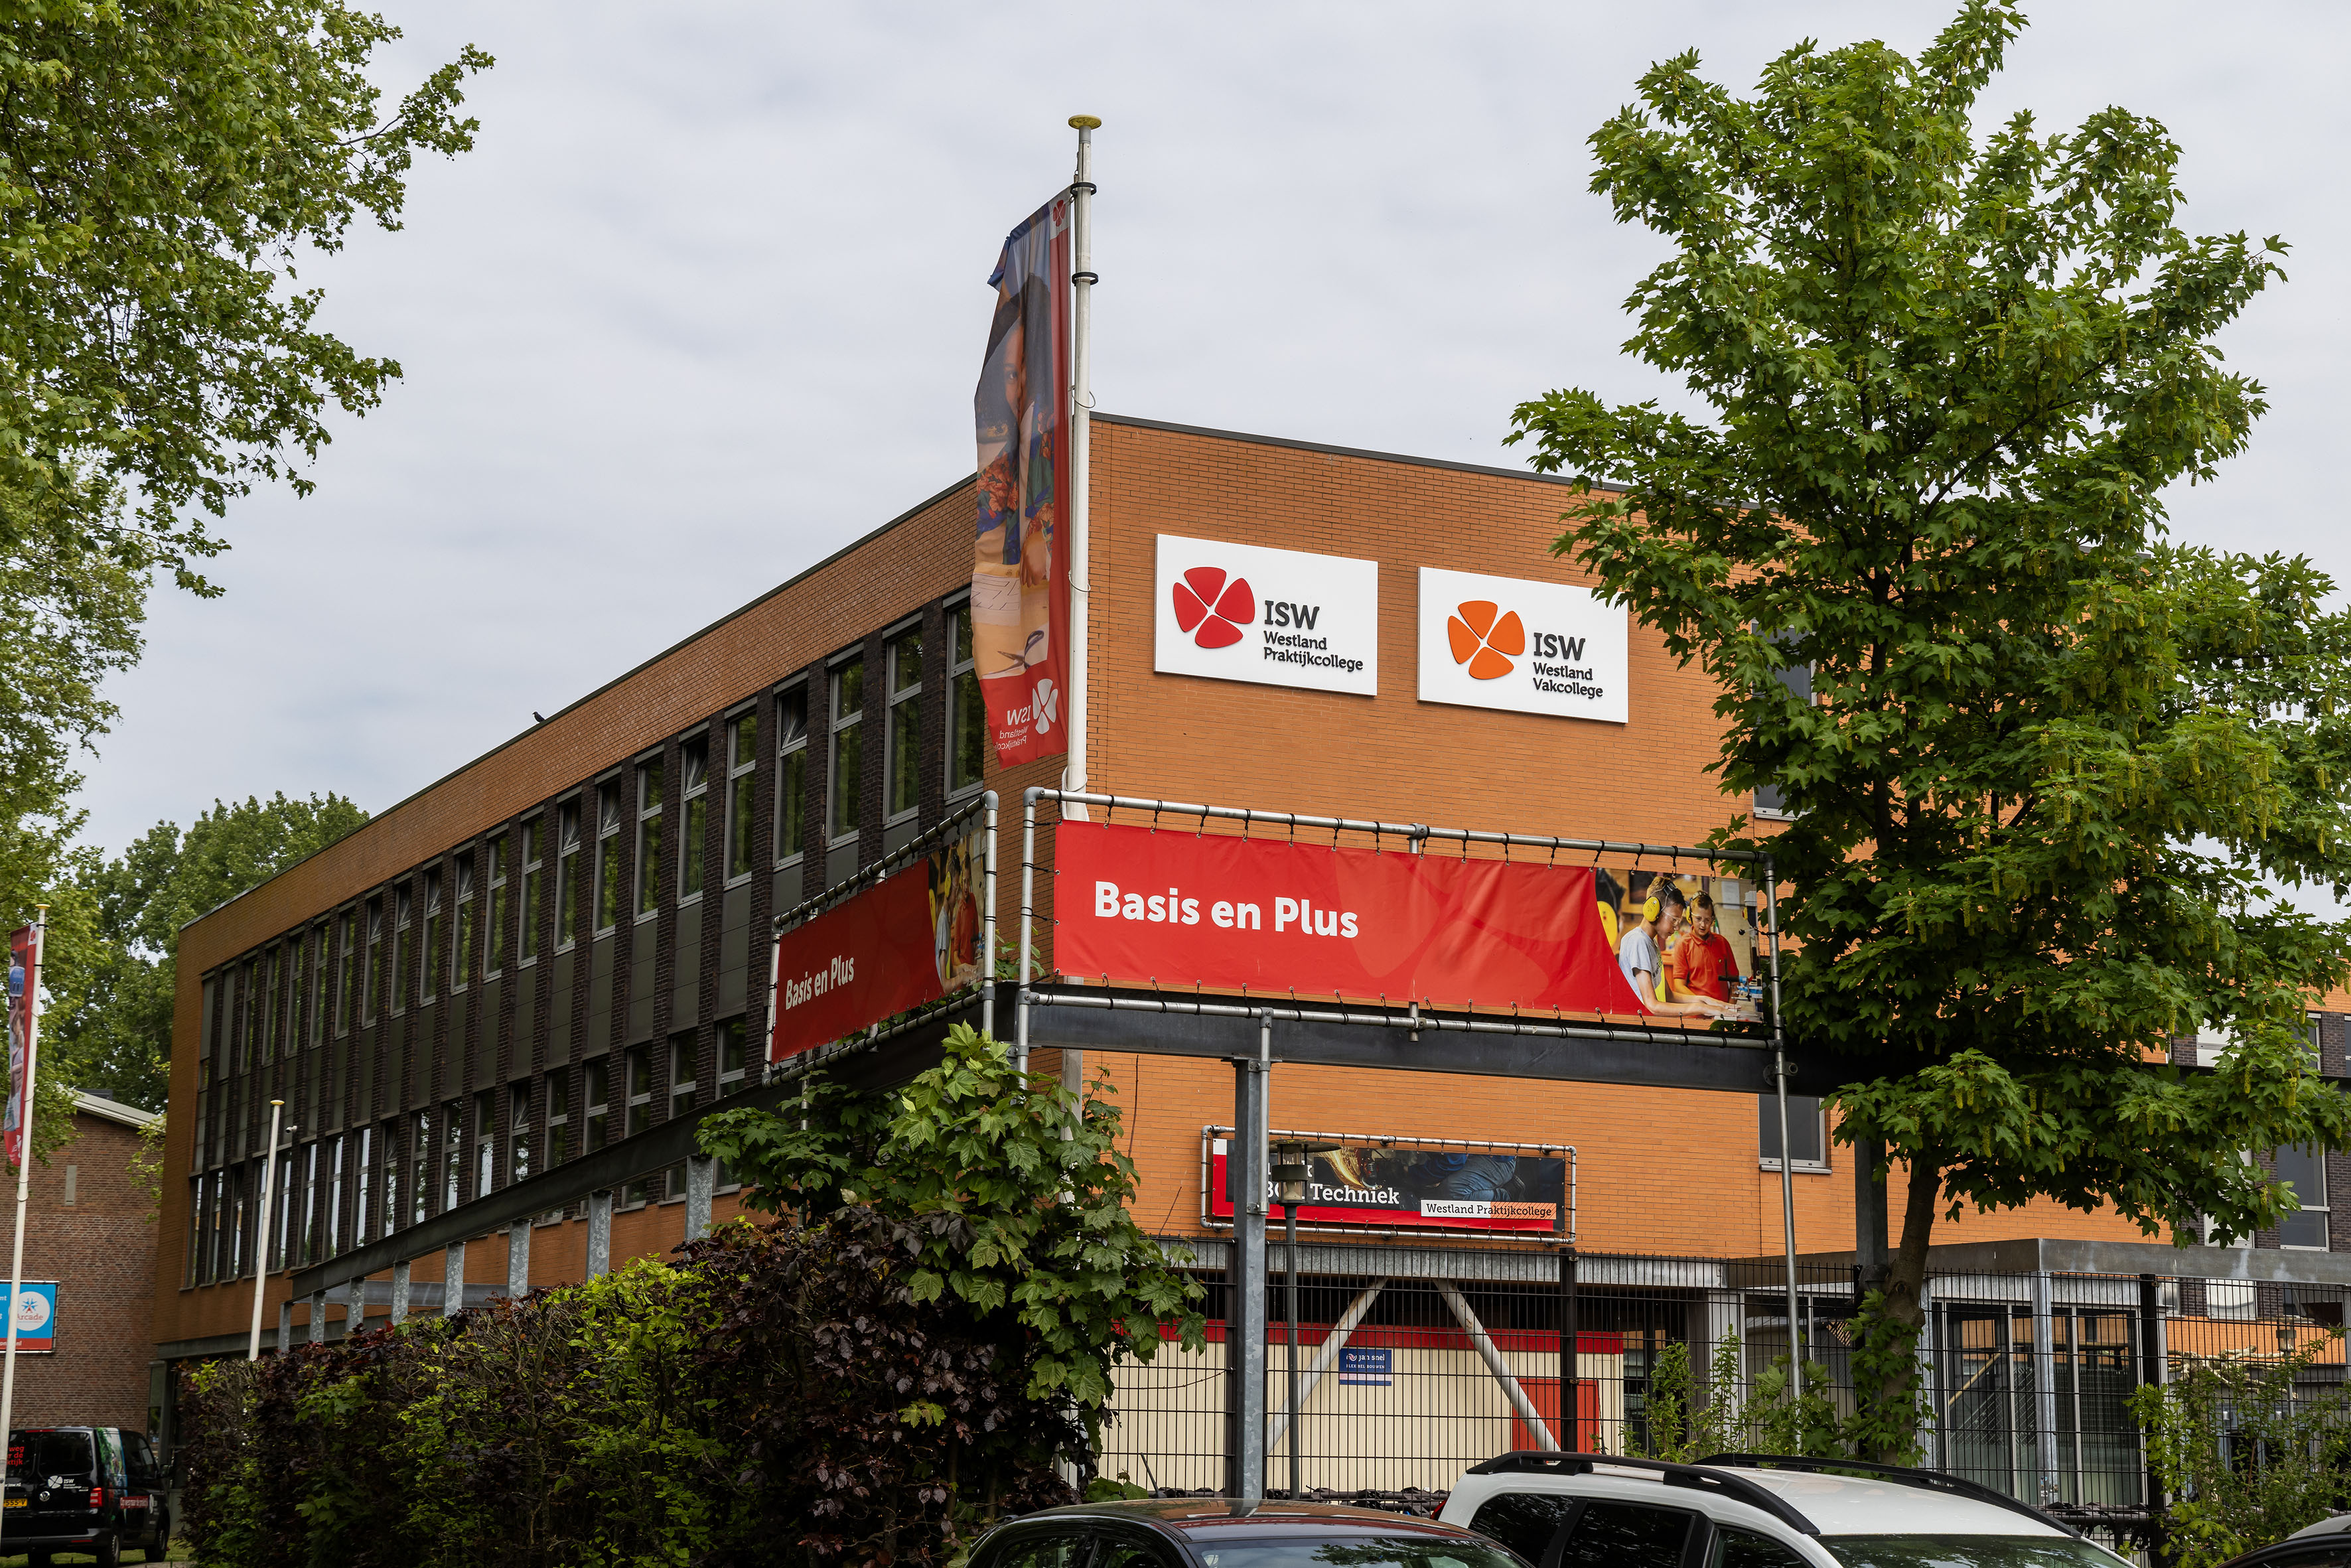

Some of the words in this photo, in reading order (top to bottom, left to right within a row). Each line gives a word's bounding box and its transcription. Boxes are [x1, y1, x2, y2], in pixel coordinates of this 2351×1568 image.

[1264, 600, 1320, 630] ISW
[1263, 630, 1327, 650] Westland
[1533, 632, 1586, 661] ISW
[1263, 646, 1364, 672] Praktijkcollege
[1533, 662, 1593, 681] Westland
[1533, 677, 1603, 699] Vakcollege
[1095, 881, 1200, 925] Basis
[1211, 900, 1261, 930] en
[1275, 896, 1359, 938] Plus
[786, 971, 812, 1011] Basis
[814, 969, 827, 997] en
[831, 955, 855, 990] Plus
[1310, 1183, 1399, 1204] Techniek
[1426, 1203, 1474, 1214] Westland
[1476, 1204, 1551, 1218] Praktijkcollege
